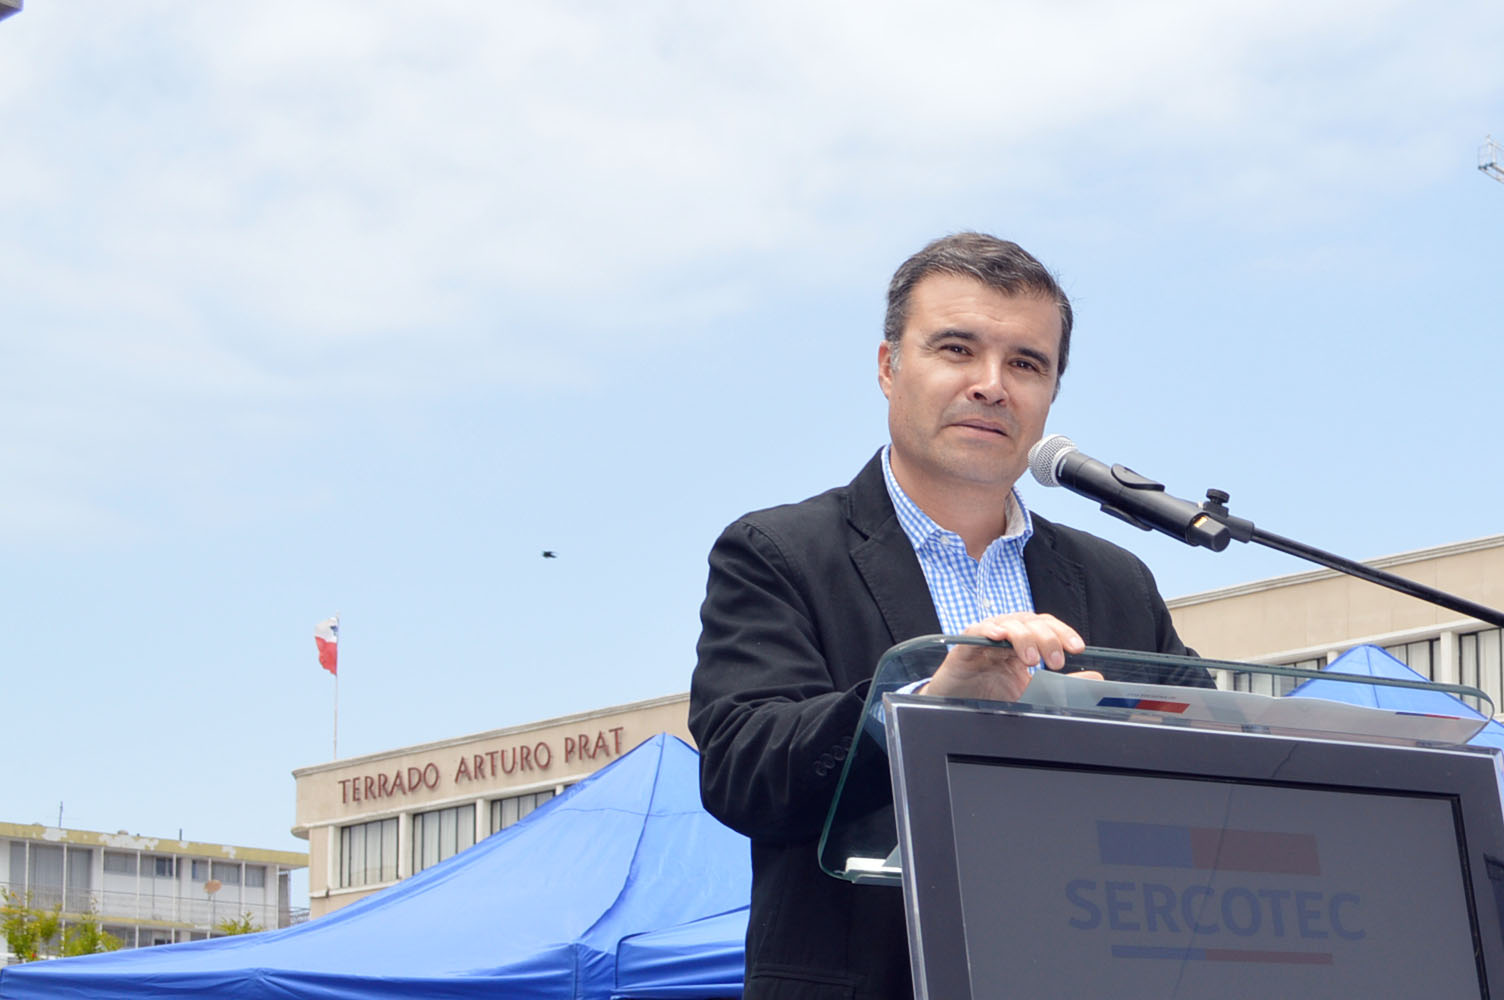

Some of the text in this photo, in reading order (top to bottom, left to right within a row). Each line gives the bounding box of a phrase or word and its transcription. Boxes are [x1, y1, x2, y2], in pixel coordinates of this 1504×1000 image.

[338, 726, 625, 804] TERRADO ARTURO PRAT
[1065, 879, 1367, 941] SERCOTEC
